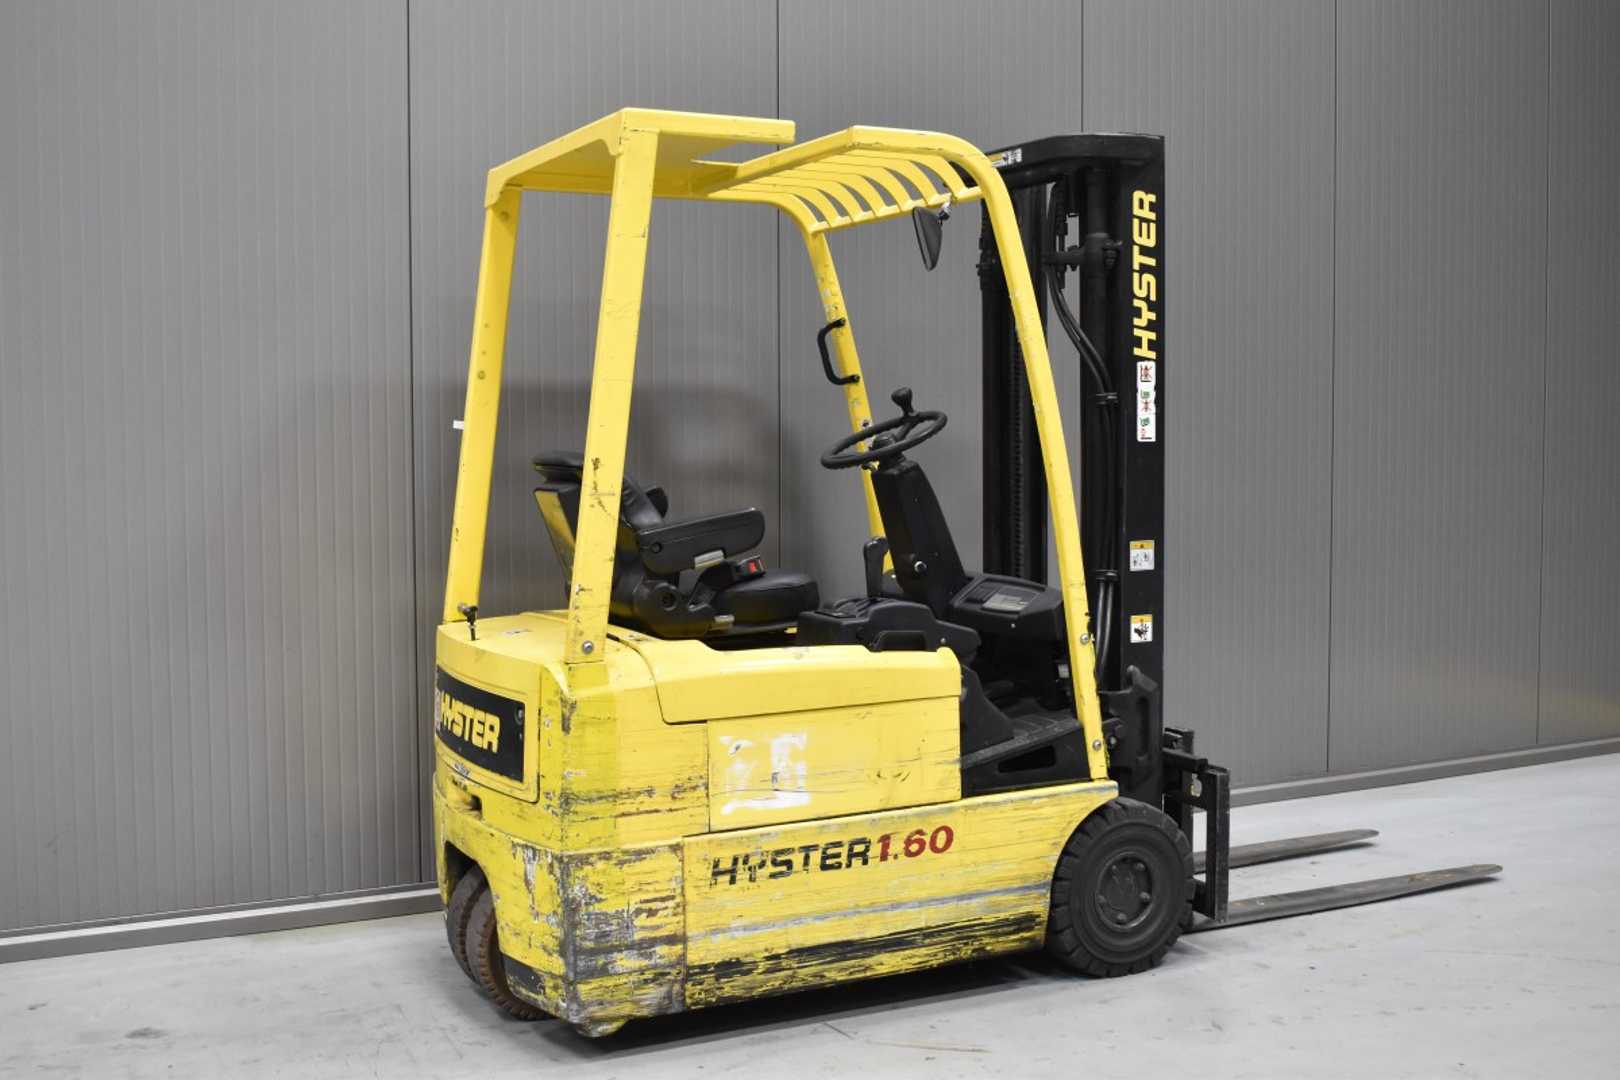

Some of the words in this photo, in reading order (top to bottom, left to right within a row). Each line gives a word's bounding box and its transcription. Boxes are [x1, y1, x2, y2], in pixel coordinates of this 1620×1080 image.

[1132, 190, 1157, 360] HYSTER
[441, 690, 501, 754] HYSTER
[709, 837, 871, 888] HYSTER
[877, 825, 954, 862] 1.60
